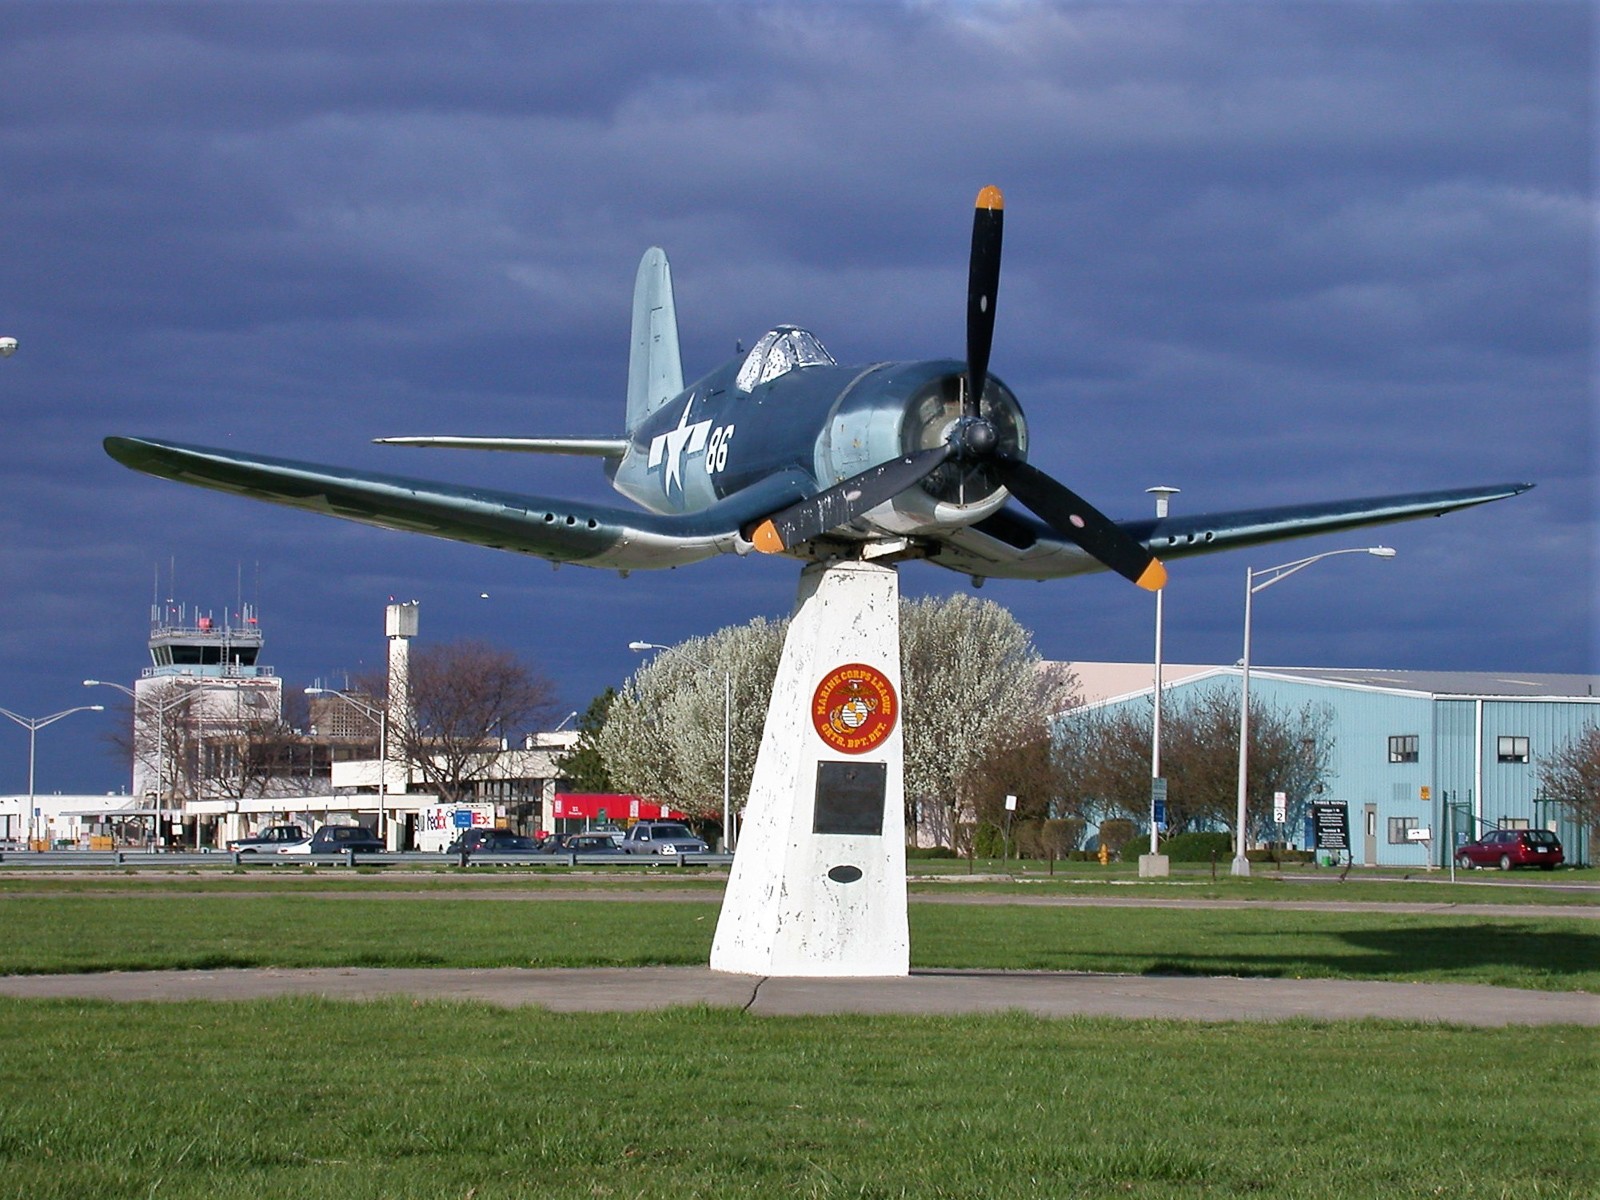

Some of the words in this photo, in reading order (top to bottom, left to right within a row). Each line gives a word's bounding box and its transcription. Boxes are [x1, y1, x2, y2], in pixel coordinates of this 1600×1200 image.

[706, 424, 734, 475] 86
[817, 675, 842, 715] MARINE
[841, 670, 871, 681] CORPS
[870, 677, 891, 715] LEAGUE
[847, 737, 869, 748] BPT.
[868, 722, 887, 742] DET.
